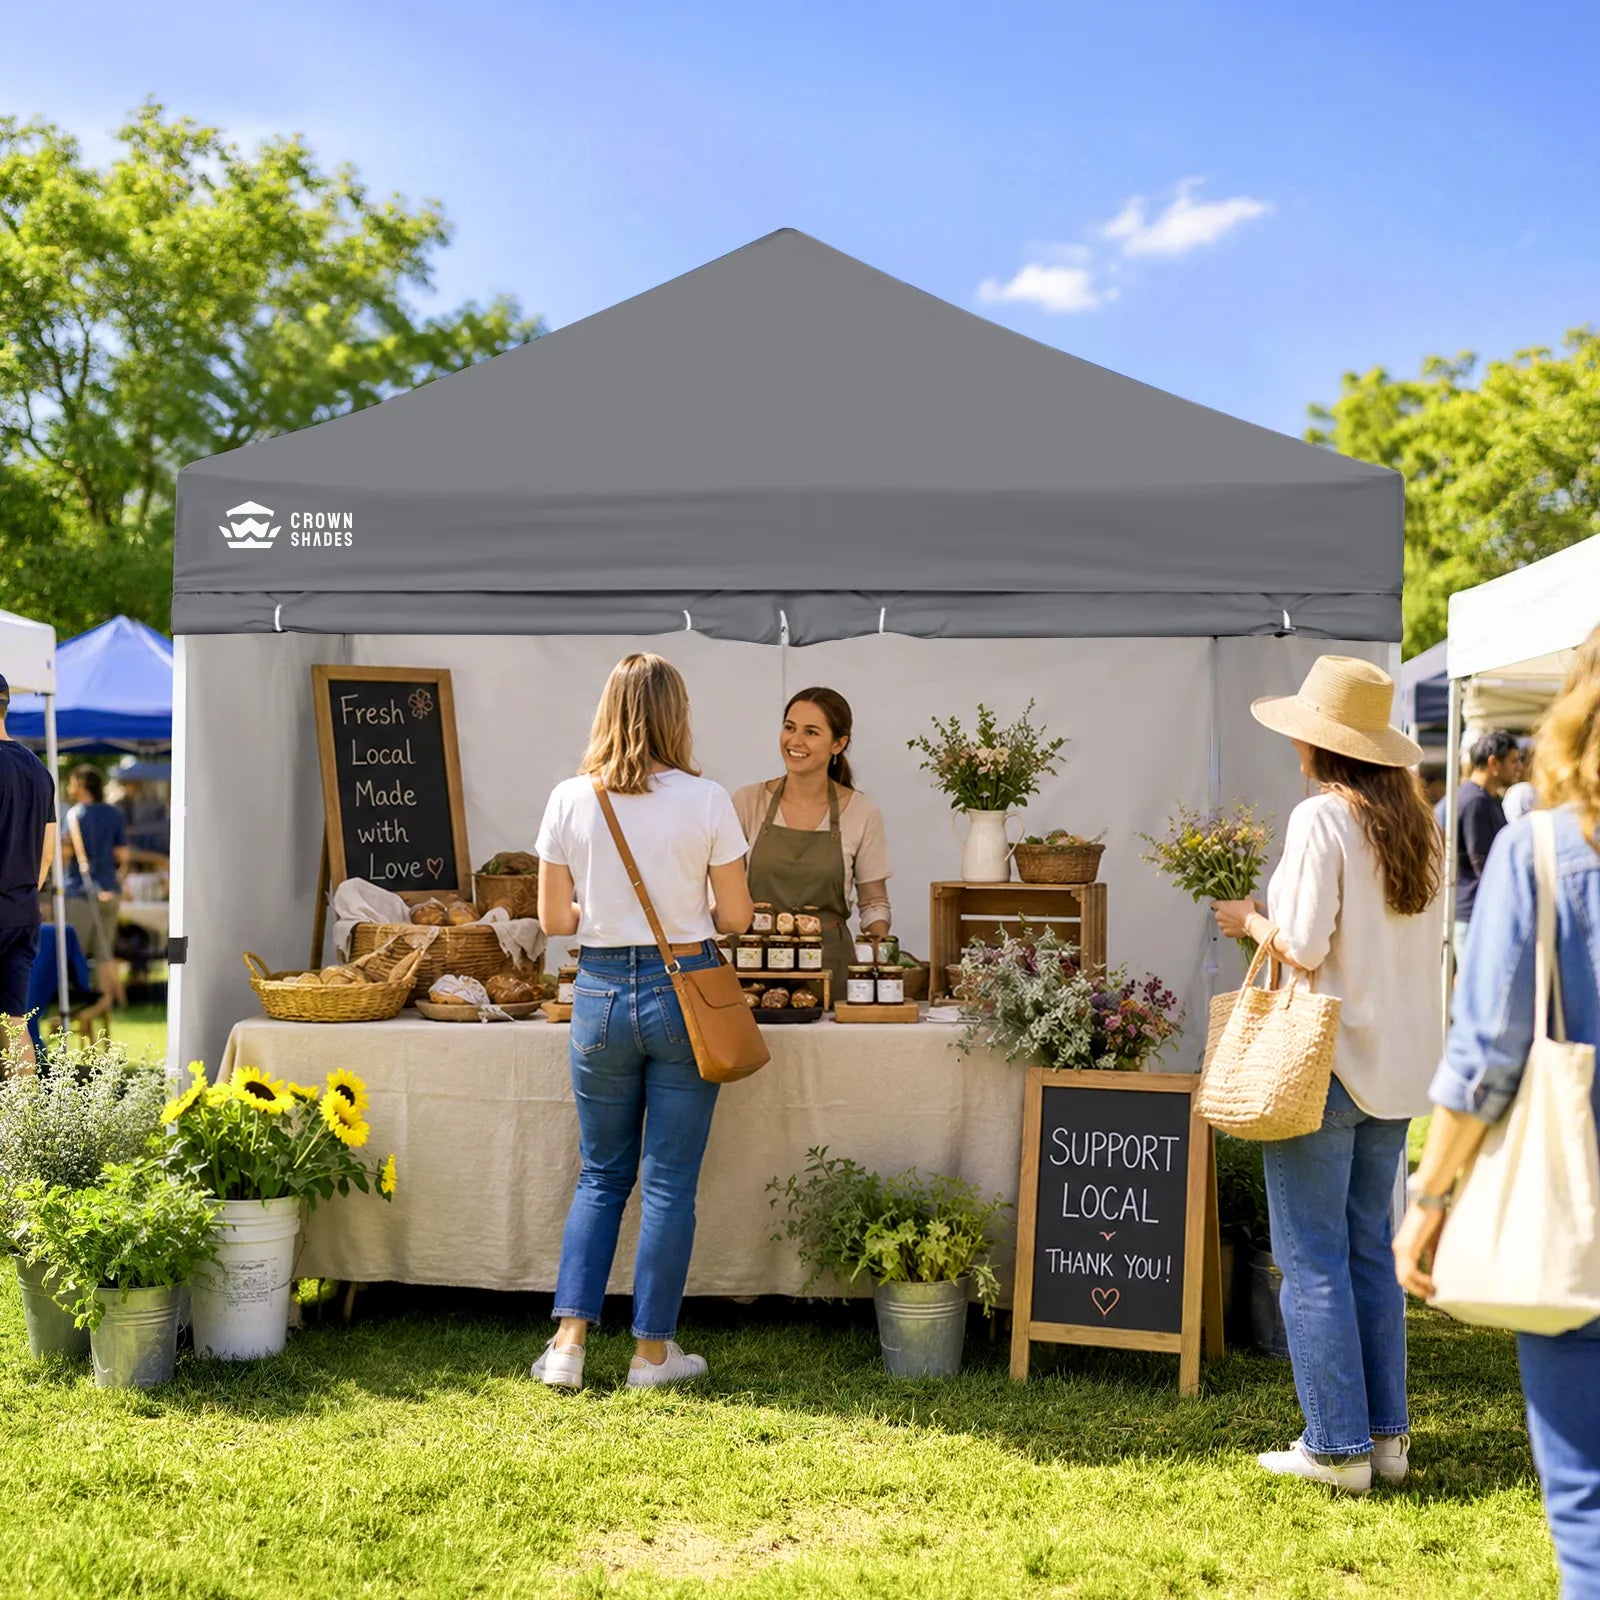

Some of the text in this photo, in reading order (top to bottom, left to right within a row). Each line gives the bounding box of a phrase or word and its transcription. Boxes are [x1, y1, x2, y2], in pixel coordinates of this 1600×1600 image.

[290, 512, 353, 529] CROWN
[290, 531, 353, 547] SHADES
[340, 693, 405, 725] Fresh
[351, 738, 416, 765] Local
[355, 779, 418, 807] Made
[357, 818, 409, 844] with
[369, 852, 424, 880] Love
[1049, 1127, 1180, 1172] SUPPORT
[1062, 1182, 1160, 1224] LOCAL
[1045, 1248, 1172, 1283] THANK YOU!
